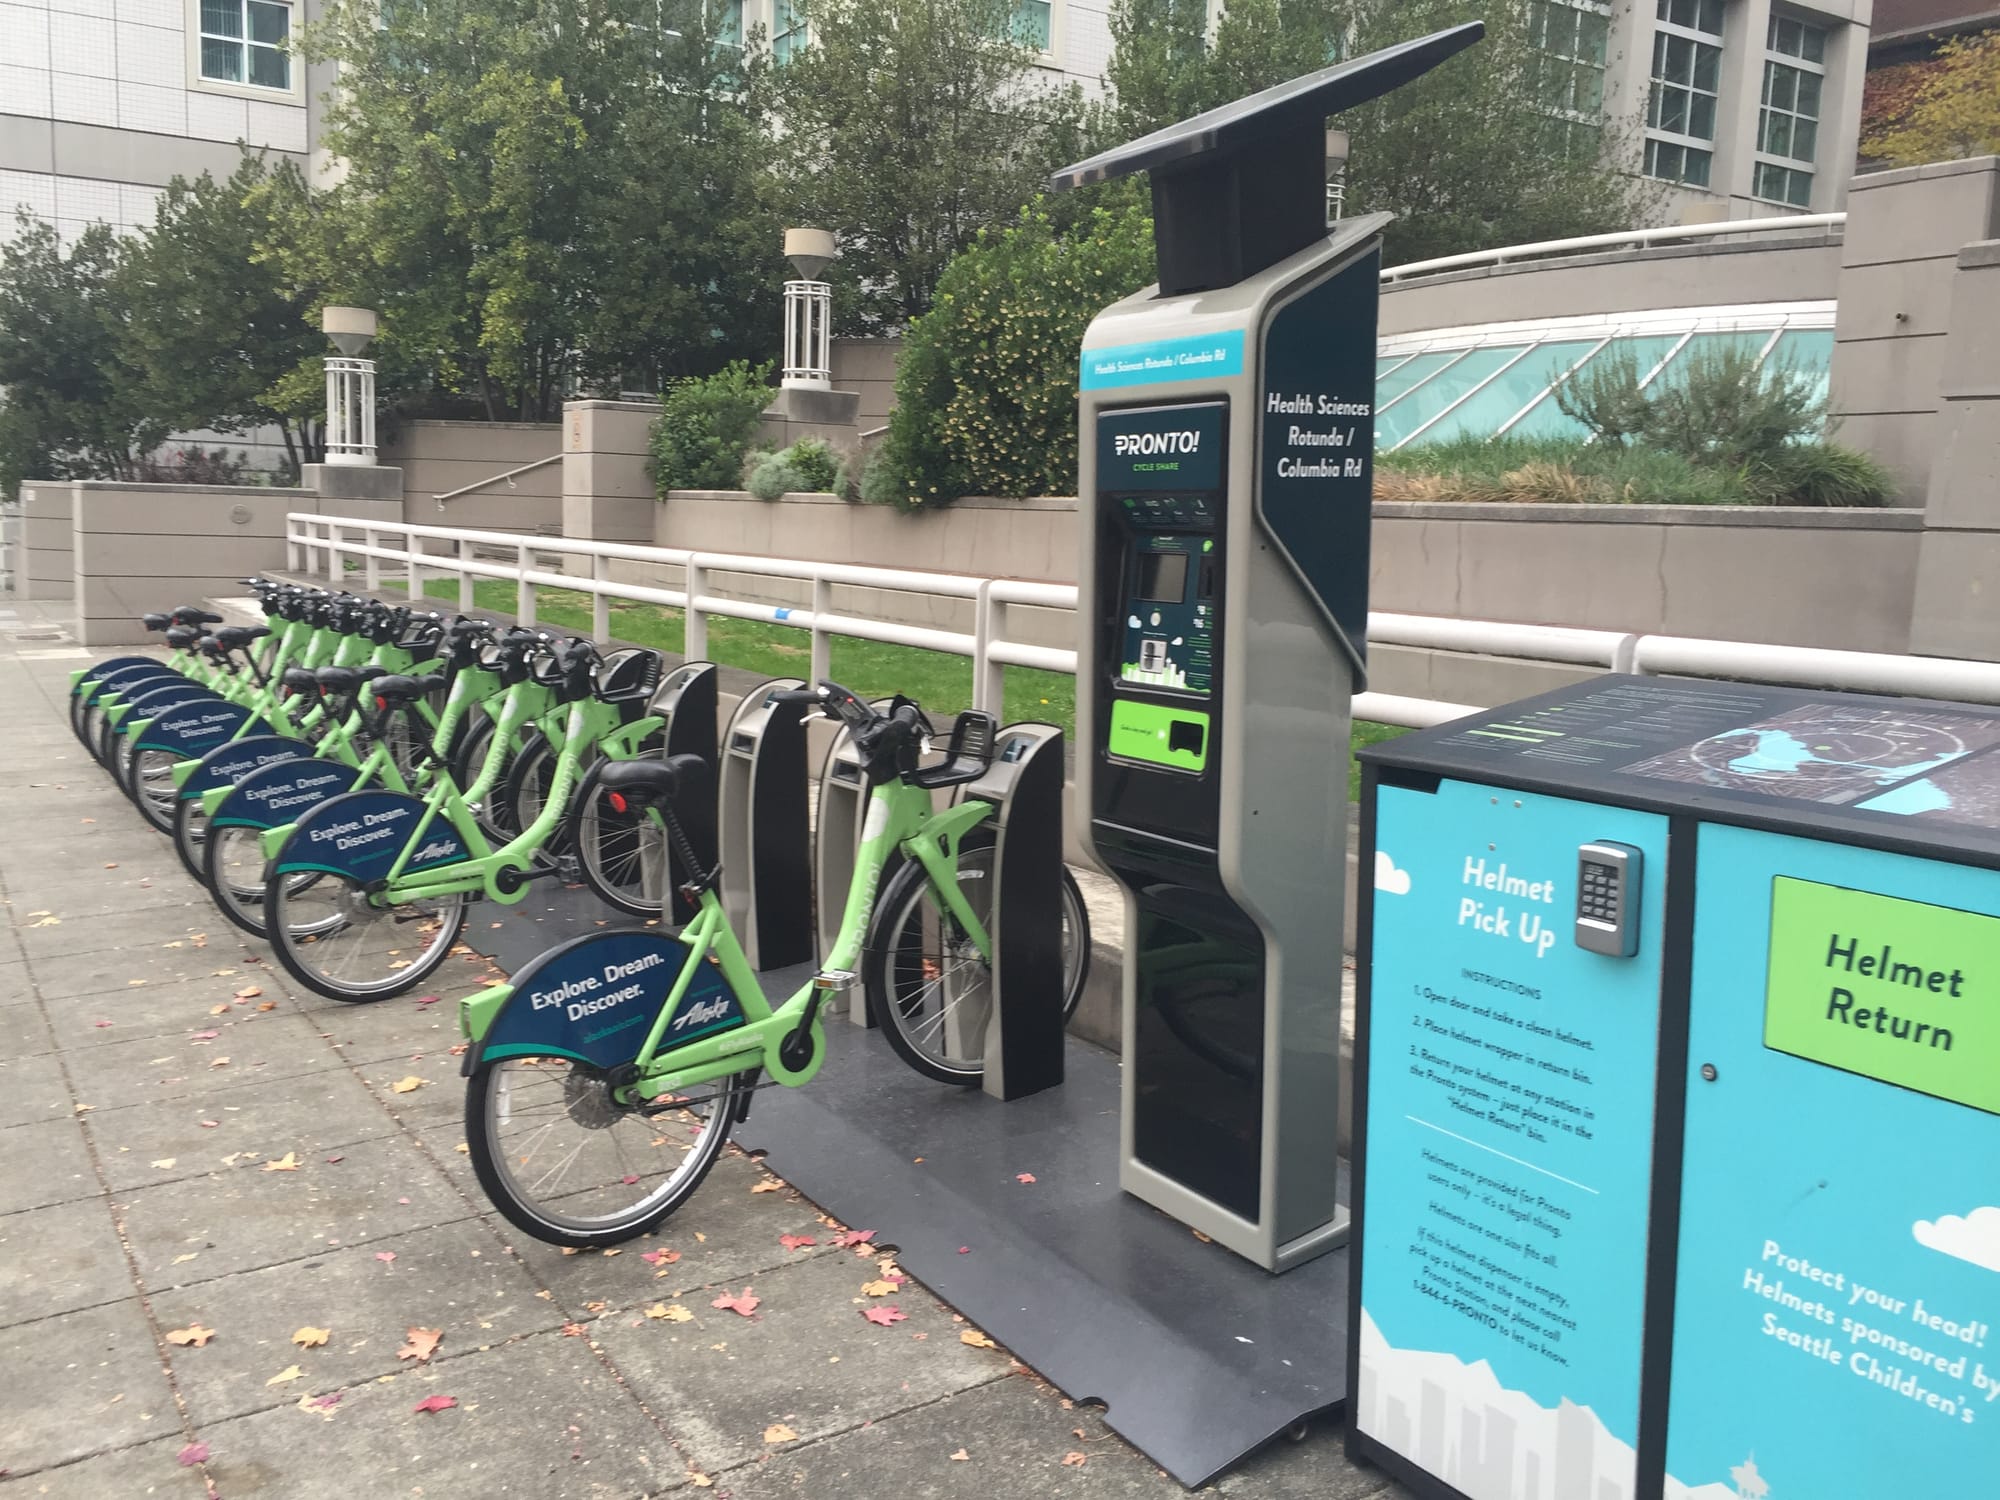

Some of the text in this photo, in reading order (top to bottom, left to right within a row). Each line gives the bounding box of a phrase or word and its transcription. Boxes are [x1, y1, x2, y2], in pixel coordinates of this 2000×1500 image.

[1095, 362, 1116, 375] Health
[1117, 360, 1144, 373] Sciences
[1145, 356, 1173, 369] Rotunda
[1179, 352, 1213, 365] Columbia
[1214, 349, 1226, 361] Rd
[1267, 392, 1370, 416] Health Sciences
[1115, 431, 1200, 456] PRONTO!
[1288, 426, 1354, 446] Rotunda /
[1133, 462, 1179, 472] CYCLE SHARE
[1277, 457, 1362, 478] Columbia Rd
[161, 712, 238, 732] Explore. Dream.
[180, 725, 224, 738] Discover.
[210, 751, 298, 776] Explore. Dream.
[245, 774, 341, 801] Explore. Dream.
[269, 791, 325, 809] Discover.
[309, 808, 410, 842] Explore. Dream.
[336, 827, 394, 850] Discover.
[1462, 856, 1555, 903] Helmet
[1457, 898, 1555, 958] Pick Up
[1826, 933, 1964, 998] Helmet
[530, 952, 665, 1012] Explore. Dream.
[1461, 968, 1542, 1000] INSTRUCTIONS
[566, 982, 645, 1023] Discover.
[1423, 987, 1448, 1004] Open
[1449, 996, 1470, 1010] door
[1472, 1007, 1491, 1018] and
[1492, 1010, 1514, 1026] take
[1525, 1020, 1552, 1037] clean
[1554, 1028, 1595, 1051] helmet.
[1826, 986, 1953, 1052] Return
[1424, 1018, 1448, 1036] Place
[1450, 1026, 1482, 1047] helmet
[1484, 1043, 1523, 1061] wrapper
[1537, 1060, 1570, 1077] return
[1421, 1048, 1451, 1068] Return
[1451, 1064, 1474, 1075] your
[1475, 1067, 1508, 1089] helmet
[1523, 1089, 1543, 1104] any
[1544, 1096, 1581, 1115] station
[1410, 1064, 1424, 1078] the
[1426, 1068, 1457, 1089] Pronto
[1458, 1084, 1490, 1101] system
[1575, 1125, 1594, 1140] the
[1421, 1148, 1458, 1172] Helmets
[1477, 1175, 1518, 1197] provided
[1537, 1196, 1571, 1220] Pronto
[1428, 1200, 1466, 1226] Helmets
[1445, 1239, 1476, 1262] helmet
[1423, 1265, 1452, 1288] Pronto
[1761, 1240, 1988, 1348] Protect your head!
[1743, 1268, 2000, 1402] Helmets sponsored by
[1761, 1312, 1974, 1424] Seattle Children's
